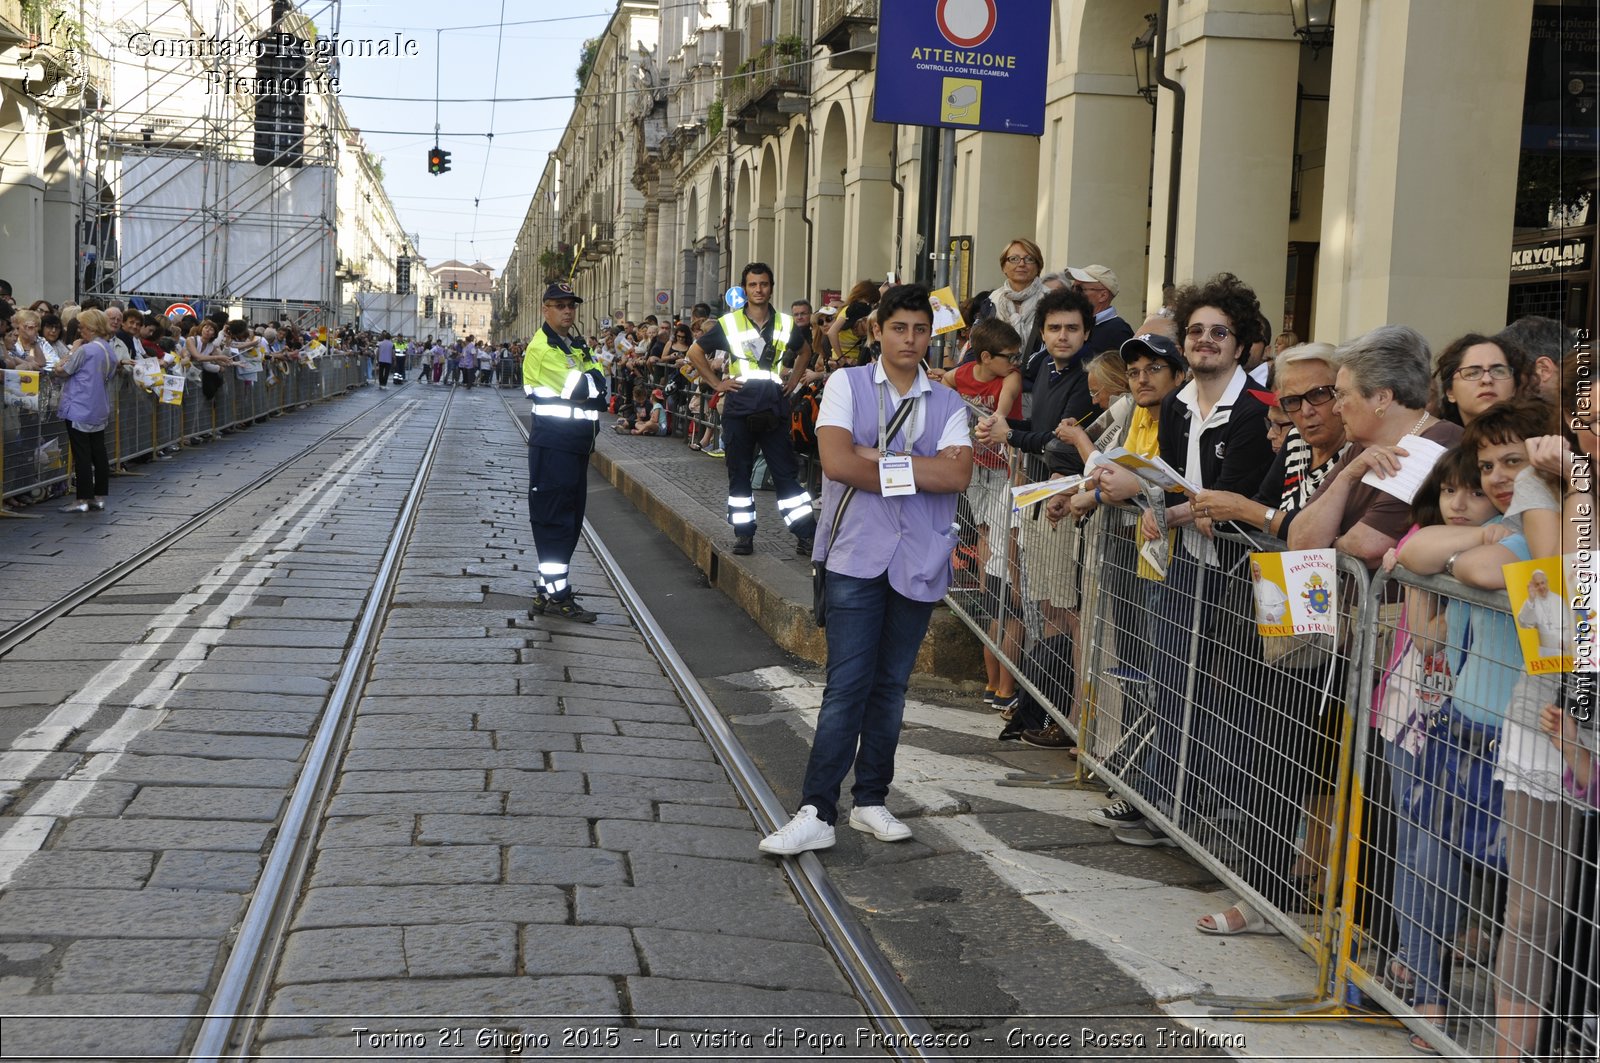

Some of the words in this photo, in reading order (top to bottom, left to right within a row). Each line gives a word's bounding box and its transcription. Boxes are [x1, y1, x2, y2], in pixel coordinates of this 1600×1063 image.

[911, 47, 1016, 69] ATTENZIONE
[916, 63, 954, 73] CONTROLLO
[954, 66, 968, 74] CON
[969, 68, 1009, 78] TELECAMERA
[1511, 243, 1586, 266] KRYOLAN
[1303, 554, 1323, 562] PAPA
